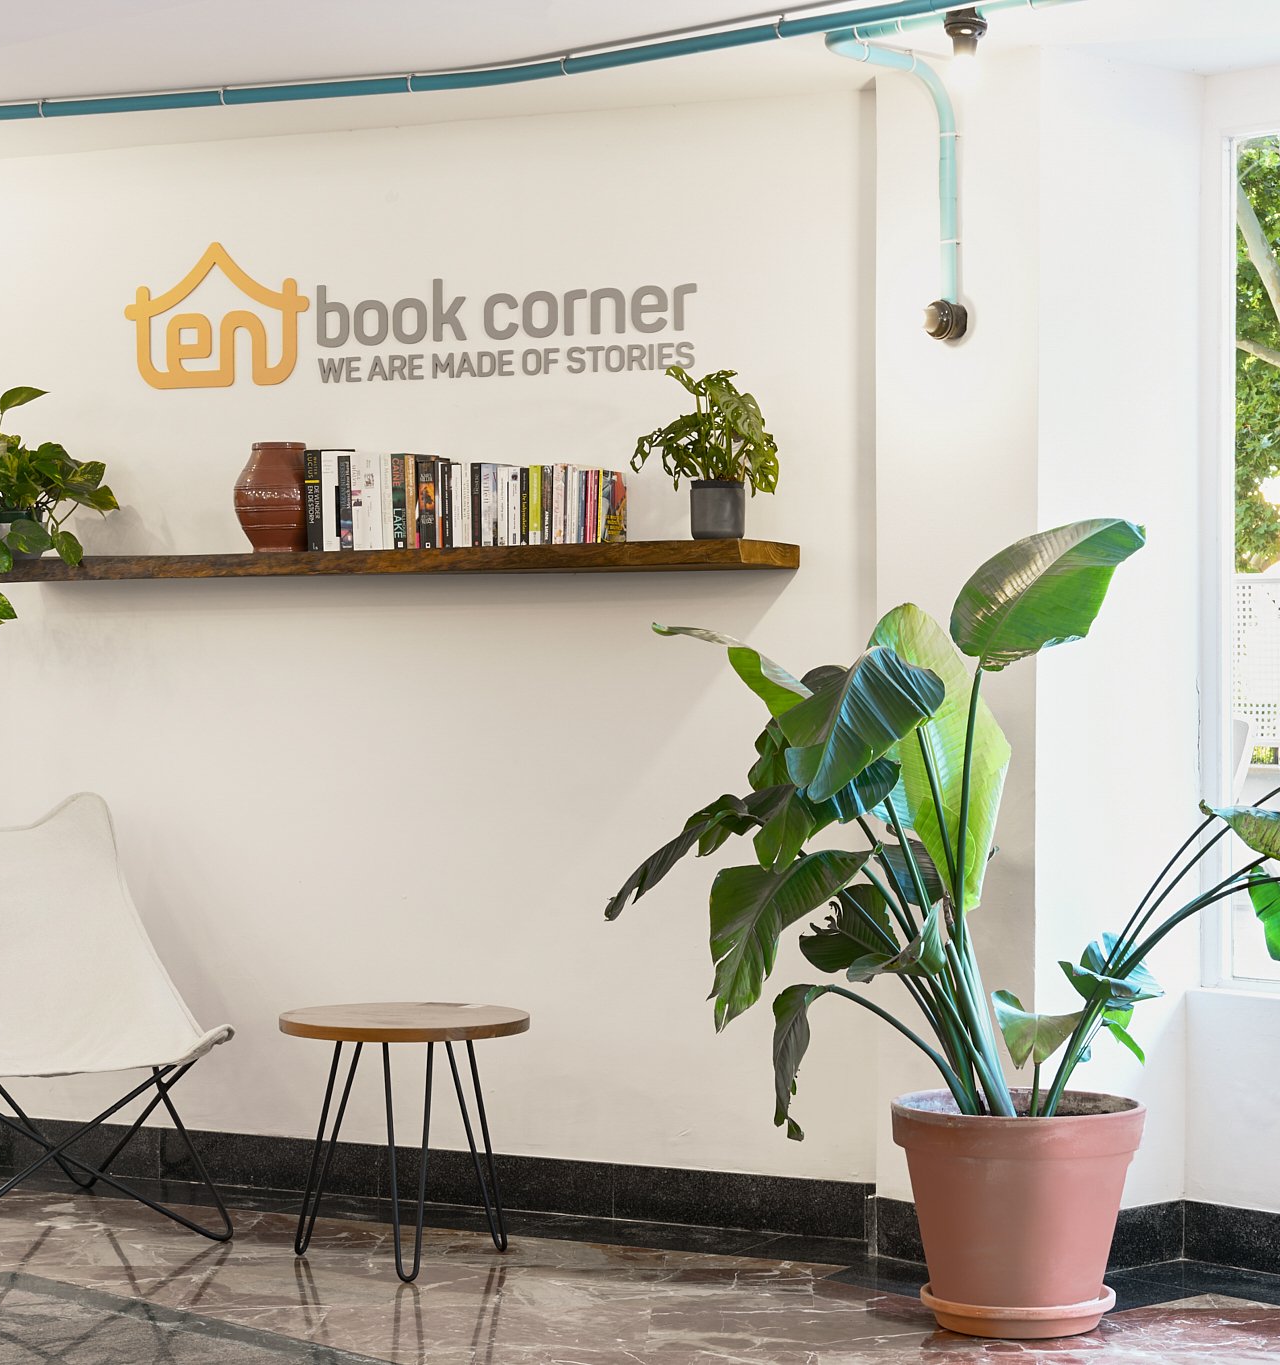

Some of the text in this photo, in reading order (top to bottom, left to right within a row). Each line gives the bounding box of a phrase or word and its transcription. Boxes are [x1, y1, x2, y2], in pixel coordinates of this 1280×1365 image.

[317, 279, 697, 348] book corner
[317, 341, 696, 383] WE ARE MADE OF STORIES
[392, 458, 400, 487] CAINE
[308, 485, 313, 494] EN
[393, 508, 403, 539] LAKE
